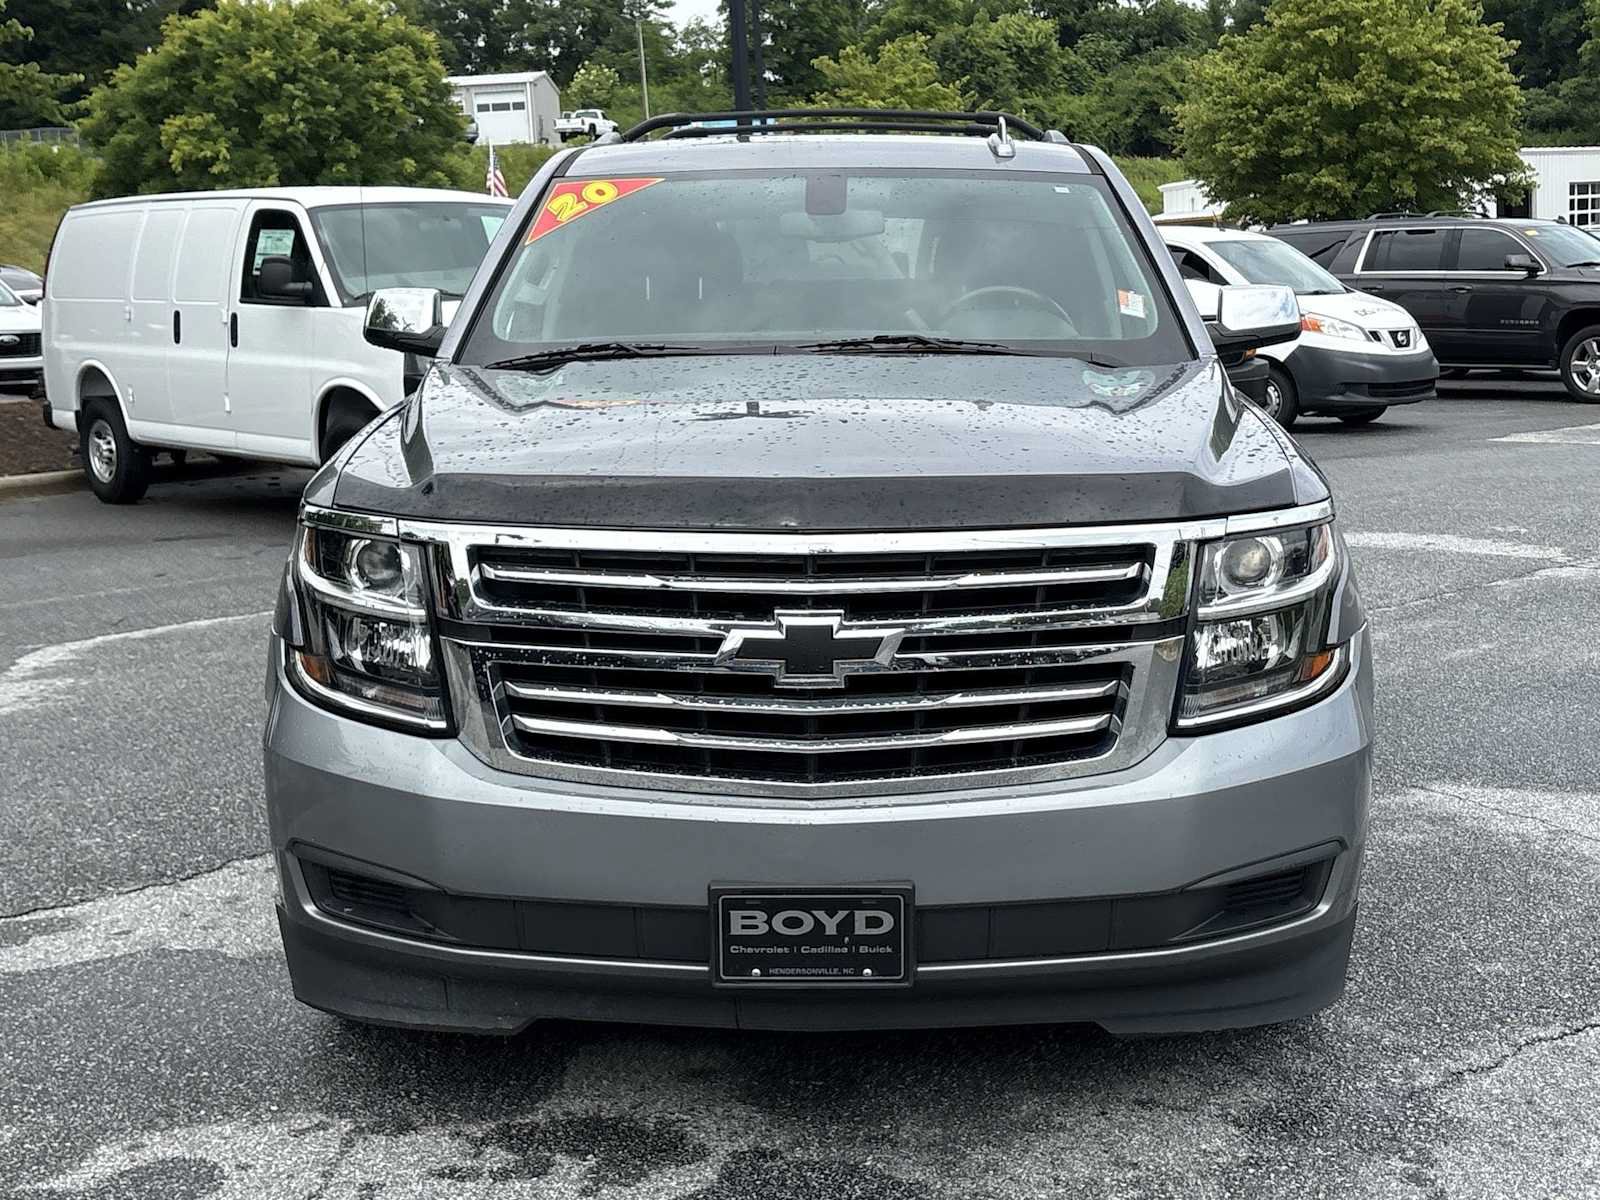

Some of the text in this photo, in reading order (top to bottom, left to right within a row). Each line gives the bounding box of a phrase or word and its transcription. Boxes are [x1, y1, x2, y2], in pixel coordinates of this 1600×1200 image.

[547, 181, 618, 222] 20
[728, 910, 895, 936] BOYD
[730, 945, 893, 954] Chevrolet Cadillac Buick
[843, 967, 855, 976] NC
